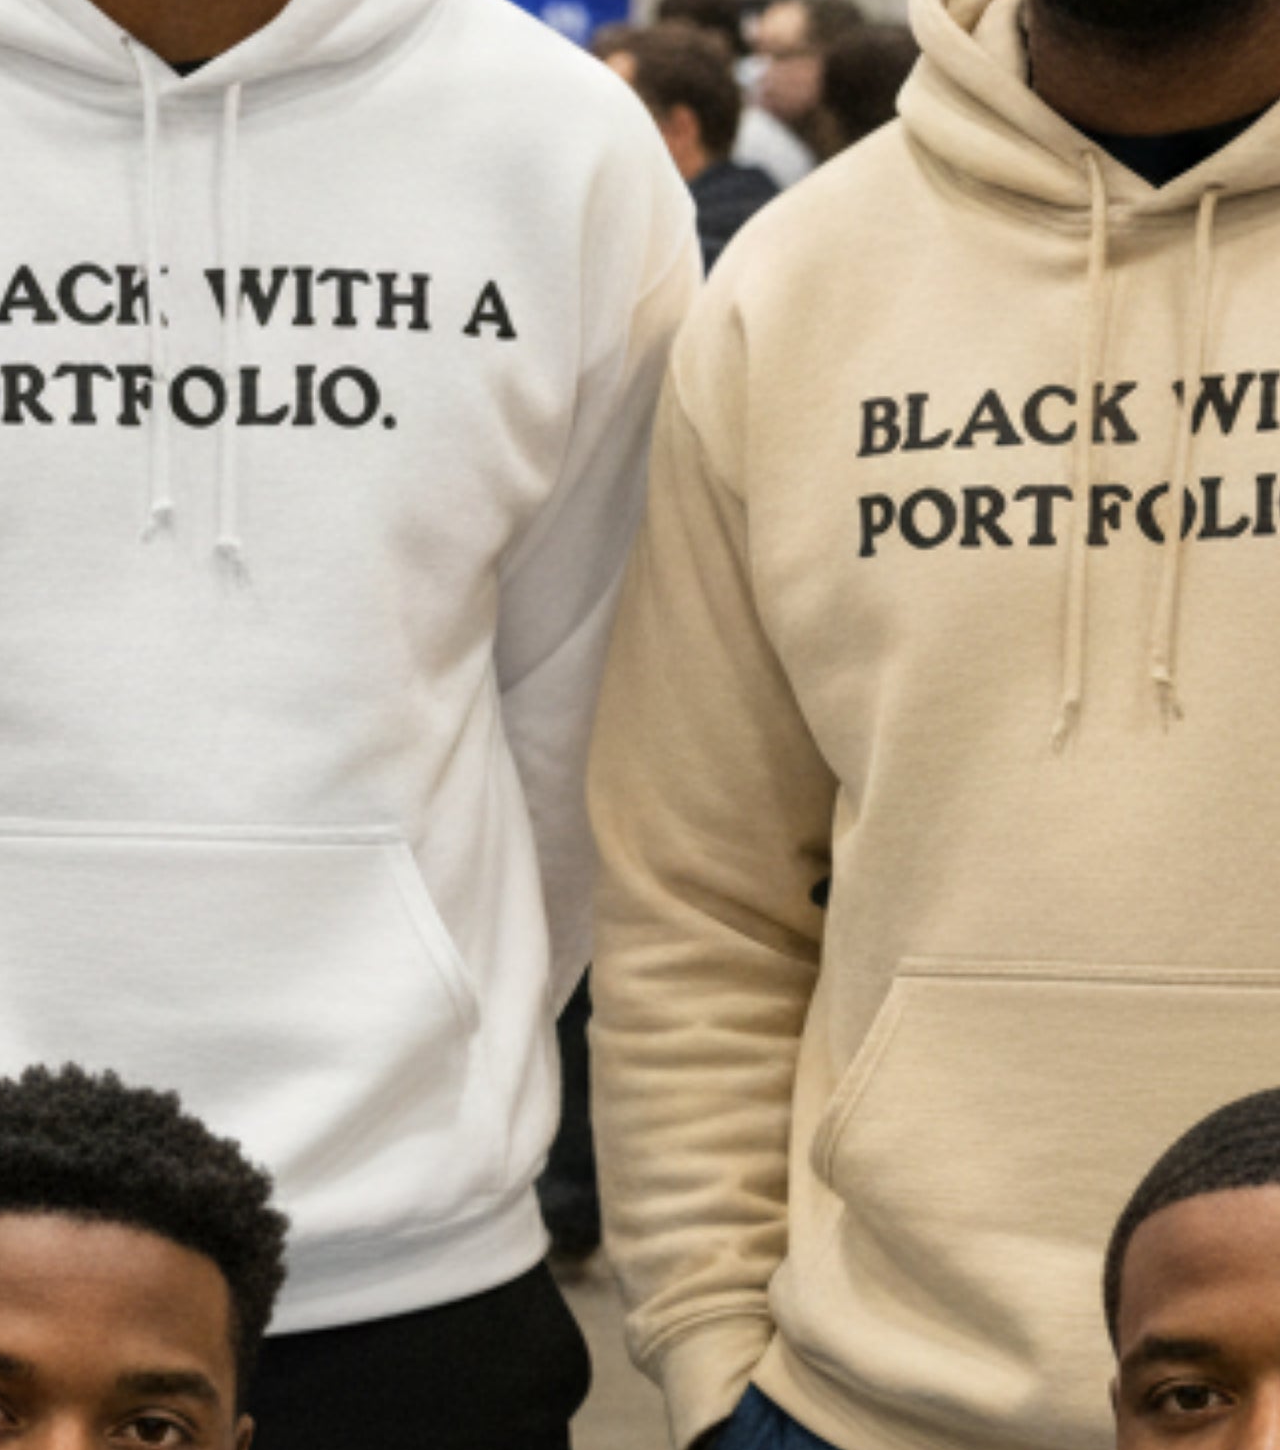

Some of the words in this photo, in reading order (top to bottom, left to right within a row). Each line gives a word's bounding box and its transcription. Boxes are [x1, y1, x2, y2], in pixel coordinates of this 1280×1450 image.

[203, 265, 431, 332] WITH
[463, 280, 518, 340] A
[856, 380, 1140, 457] BLACK
